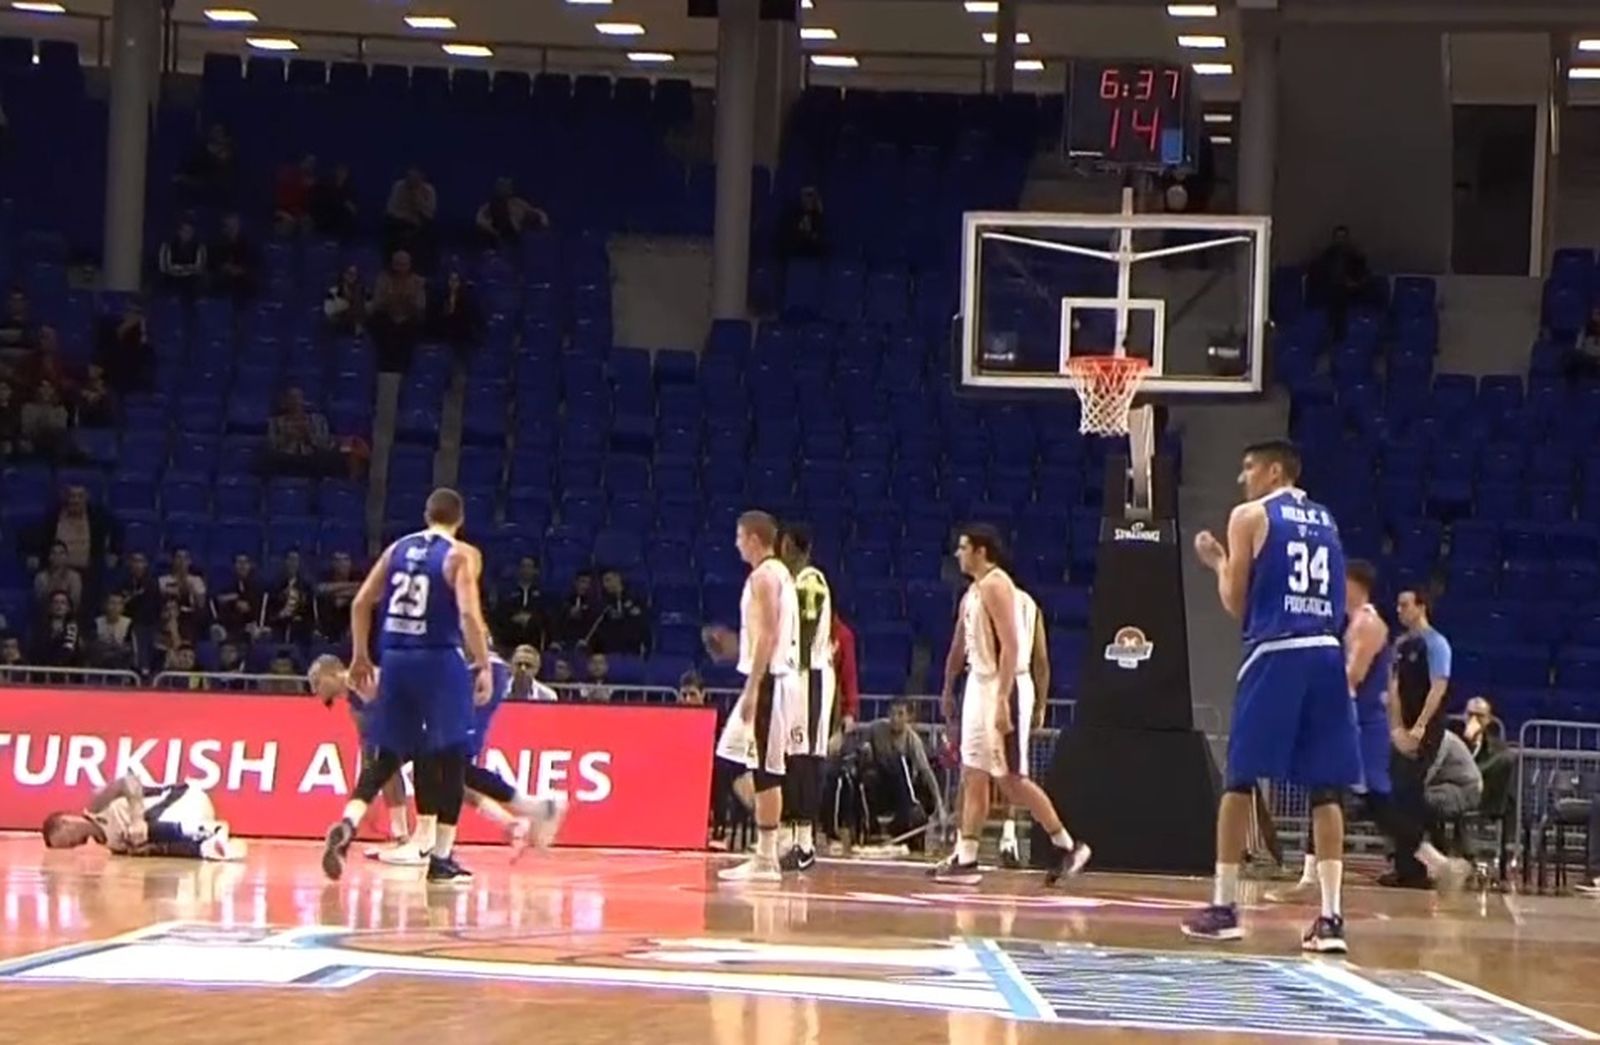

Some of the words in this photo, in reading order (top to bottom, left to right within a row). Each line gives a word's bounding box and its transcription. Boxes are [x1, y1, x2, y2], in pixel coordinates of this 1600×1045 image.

[1101, 69, 1179, 99] 6:37
[1110, 108, 1159, 151] 14
[1287, 541, 1330, 596] 34
[388, 571, 430, 618] 29
[298, 742, 612, 802] ANES
